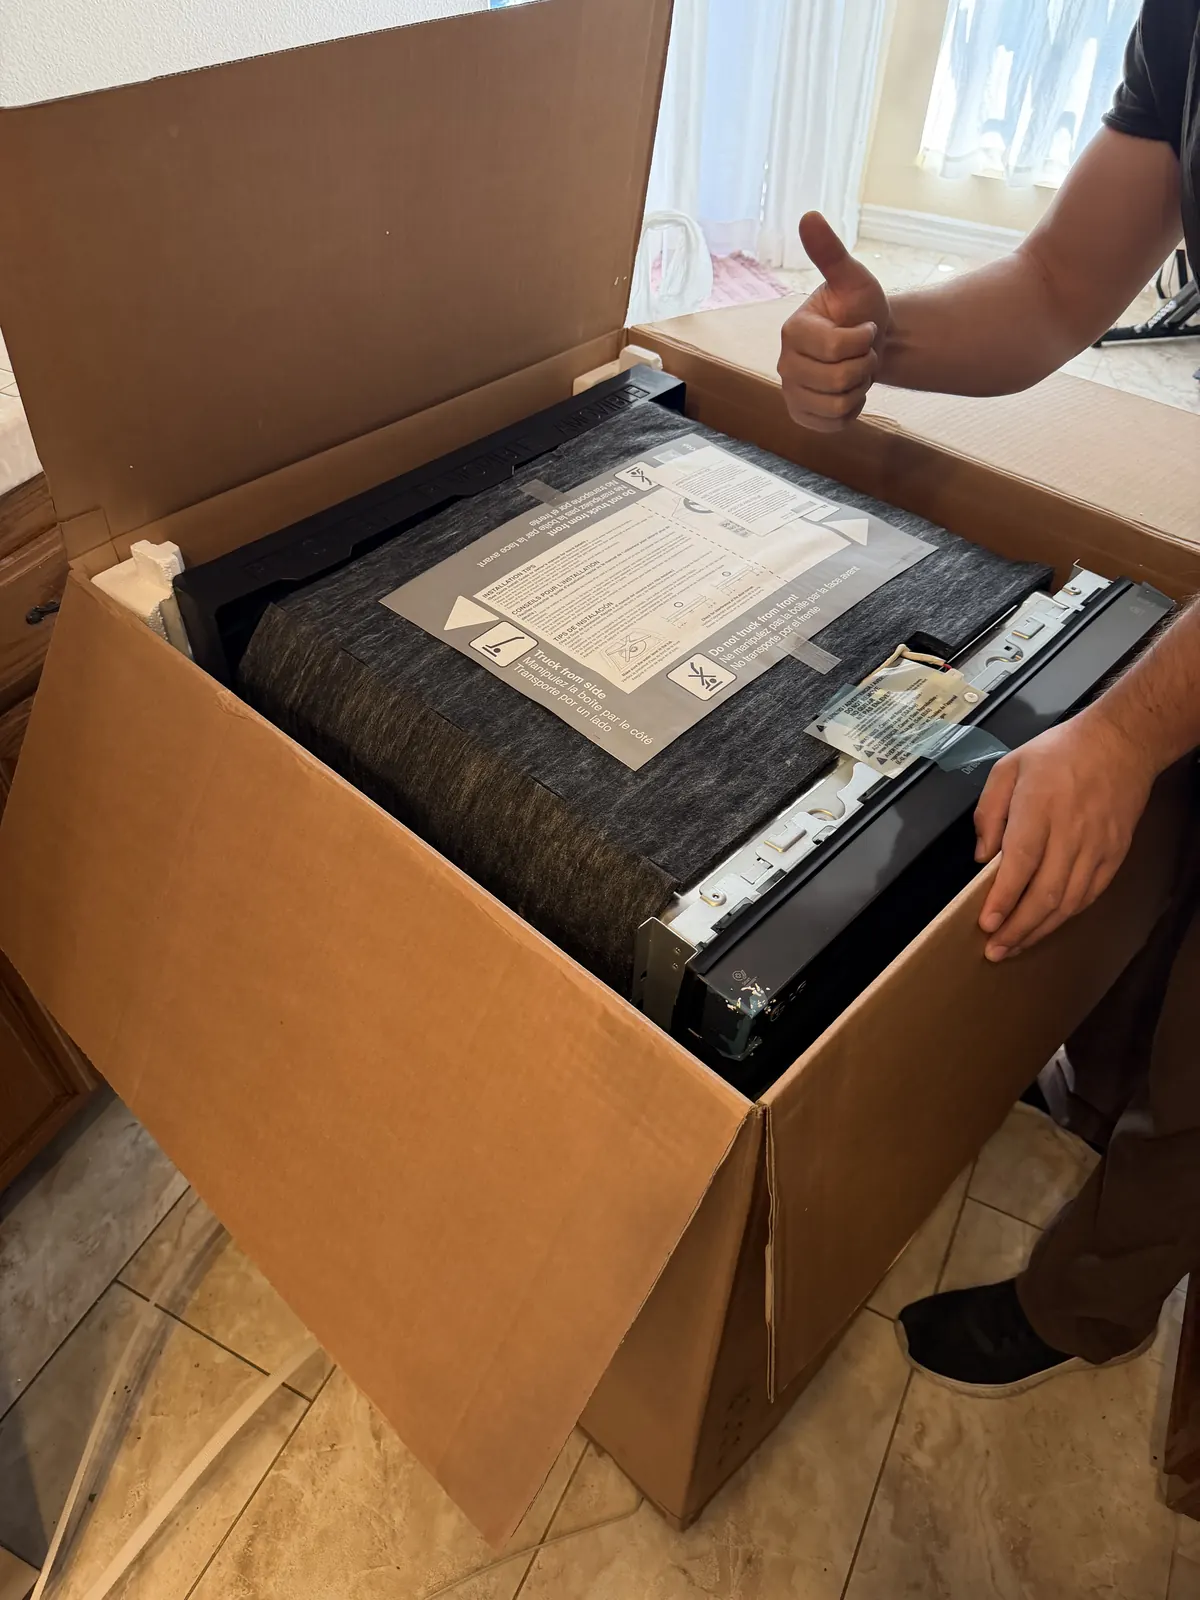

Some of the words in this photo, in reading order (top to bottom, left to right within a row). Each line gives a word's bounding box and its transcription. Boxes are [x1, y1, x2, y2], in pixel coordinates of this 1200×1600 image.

[604, 479, 619, 487] No
[613, 484, 628, 492] Ne
[570, 484, 607, 505] transporte
[606, 494, 623, 504] not
[621, 488, 636, 497] Do
[557, 501, 573, 511] por
[578, 489, 615, 510] manipulez
[563, 507, 581, 516] pas
[587, 501, 611, 514] truck
[528, 513, 553, 526] frente
[537, 518, 560, 531] boîte
[567, 512, 590, 525] from
[524, 528, 540, 538] par
[546, 522, 570, 536] front
[498, 541, 520, 553] face
[476, 552, 501, 568] avant
[839, 565, 860, 580] avant
[481, 571, 523, 598] INSTALLATION
[521, 563, 537, 573] TIPS
[510, 595, 542, 615] CONSEILS
[539, 585, 558, 597] POUR
[555, 559, 600, 587] L'INSTALLATION
[822, 577, 843, 589] face
[816, 586, 829, 594] la
[805, 592, 821, 603] par
[786, 599, 810, 615] boîte
[552, 631, 568, 641] TIPS
[565, 625, 577, 633] DE
[574, 601, 614, 627] INSTALACIÓN
[780, 612, 793, 620] la
[707, 645, 725, 656] Do
[722, 634, 740, 648] not
[735, 620, 761, 637] truck
[756, 607, 780, 623] from
[775, 593, 799, 609] front
[768, 618, 785, 630] pas
[729, 659, 746, 670] No
[741, 634, 781, 662] transporte
[778, 625, 794, 637] por
[790, 619, 802, 627] el
[796, 605, 821, 622] frente
[732, 627, 771, 655] manipulez
[718, 652, 735, 663] Ne
[533, 649, 561, 670] Truck
[559, 666, 584, 684] from
[582, 681, 606, 699] side
[513, 662, 560, 696] Transporte
[556, 693, 578, 707] por
[575, 705, 591, 717] un
[588, 714, 612, 732] lado
[522, 656, 568, 687] Manipulez
[566, 683, 579, 693] la
[576, 690, 602, 711] boîte
[598, 709, 621, 722] par
[617, 719, 630, 730] le
[629, 728, 654, 745] côté
[850, 699, 863, 708] NOT
[861, 706, 874, 714] PAS
